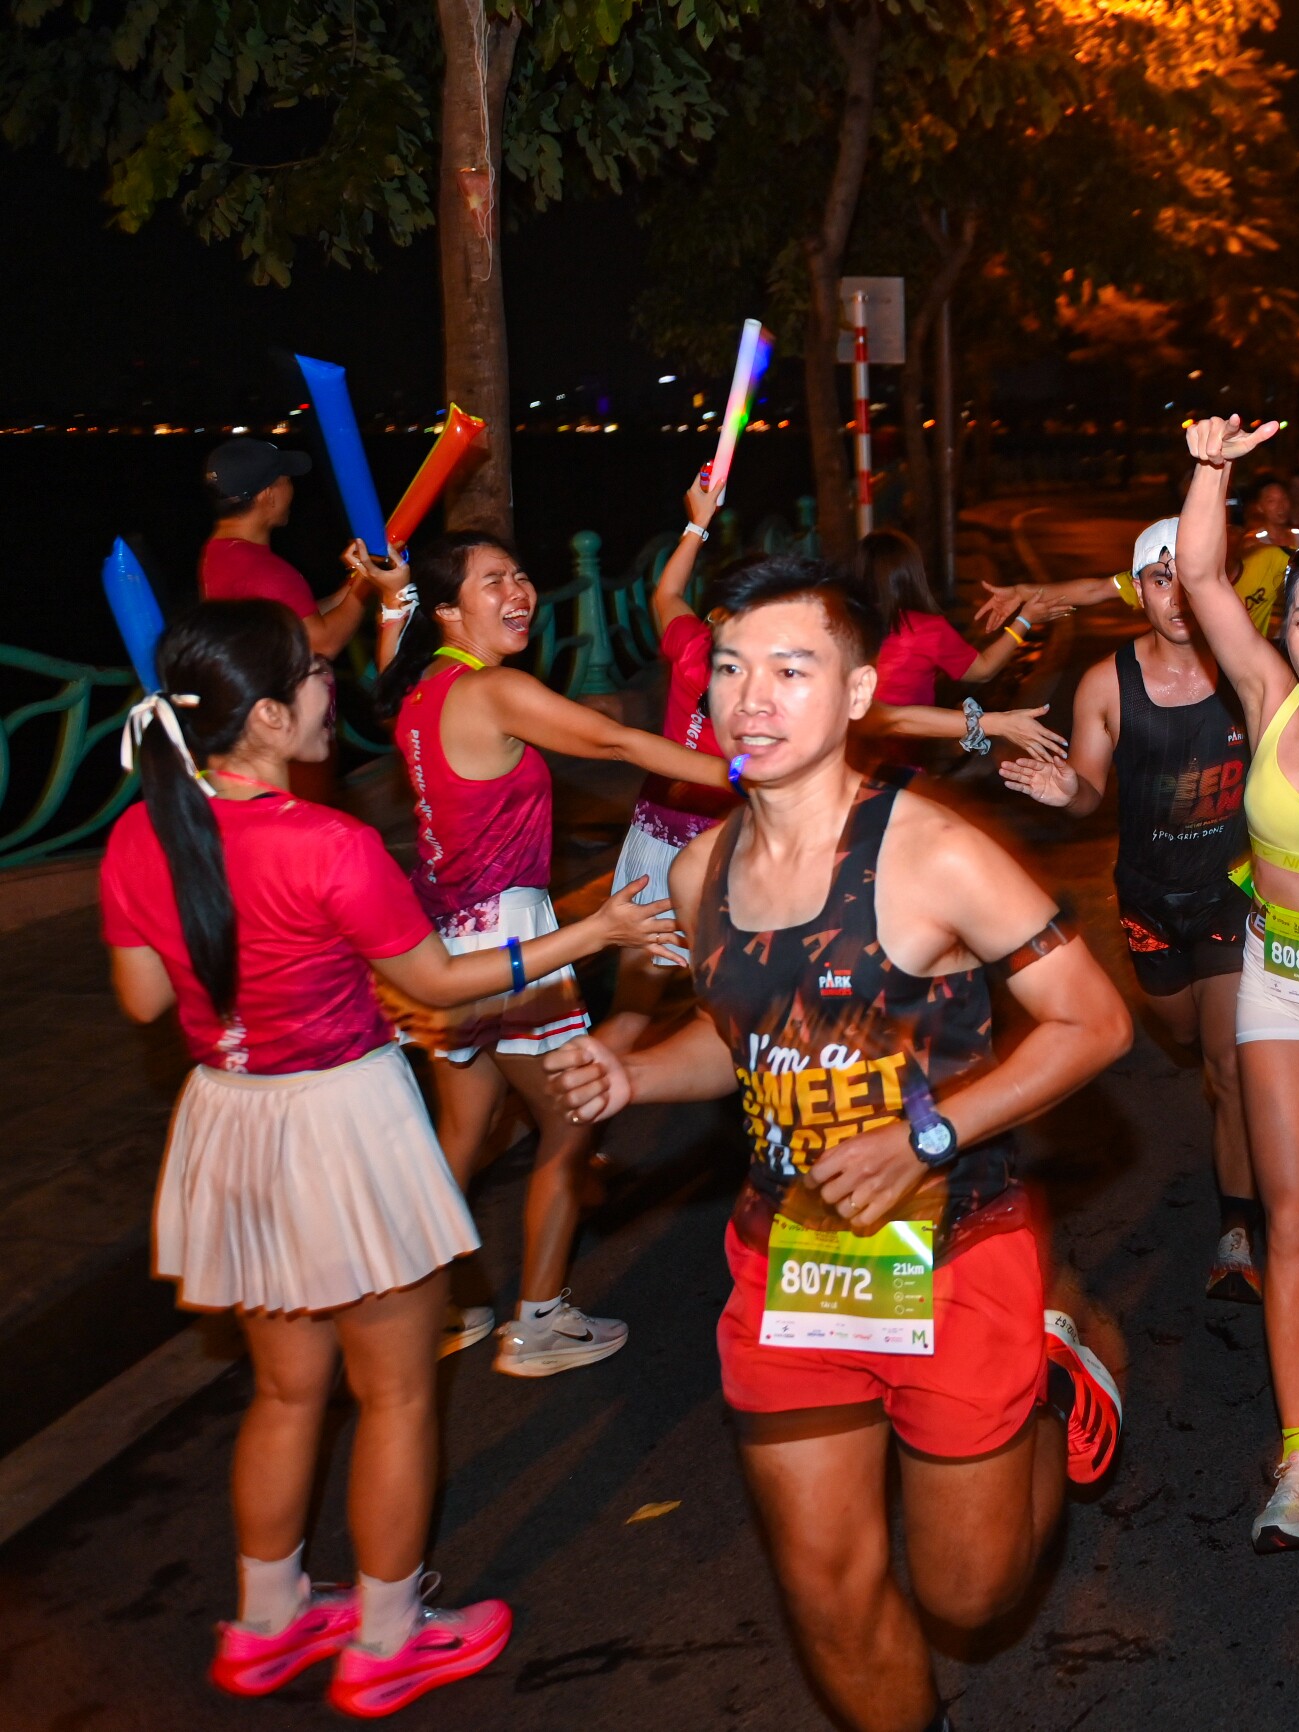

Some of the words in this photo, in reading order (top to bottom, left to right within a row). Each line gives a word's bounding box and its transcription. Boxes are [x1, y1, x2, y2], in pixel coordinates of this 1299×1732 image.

[1202, 824, 1225, 838] DONE
[819, 969, 852, 988] PARK
[749, 1033, 811, 1076] I'm
[820, 1043, 861, 1071] a
[892, 1262, 925, 1276] 21km
[781, 1260, 873, 1301] 80772
[912, 1329, 926, 1345] M
